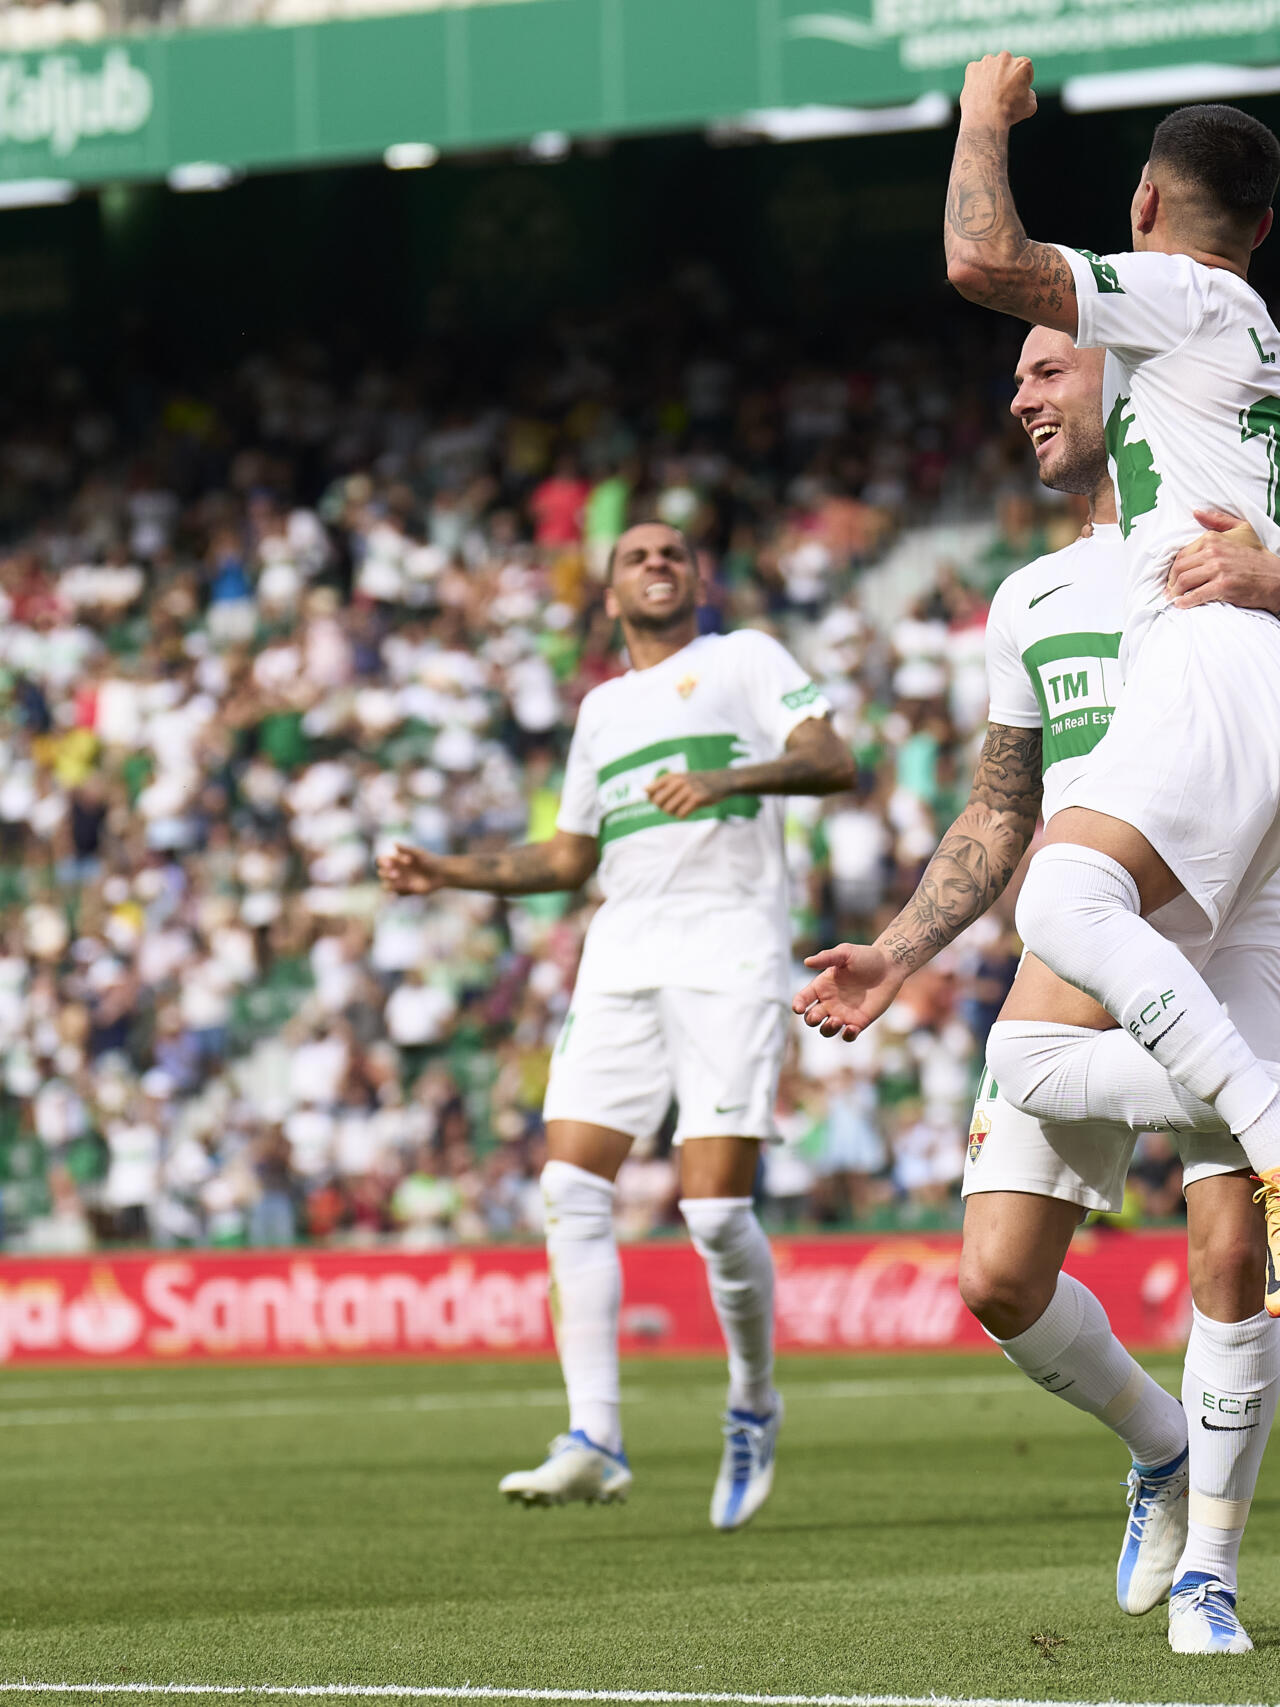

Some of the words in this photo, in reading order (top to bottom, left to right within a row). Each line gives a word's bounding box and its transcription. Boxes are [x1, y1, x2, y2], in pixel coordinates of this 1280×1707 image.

[1048, 671, 1089, 704] TM
[1050, 720, 1064, 737] TM
[1064, 712, 1088, 731] Real
[1129, 989, 1176, 1037] ECF
[142, 1259, 550, 1356] Santander
[1202, 1391, 1262, 1415] ECF
